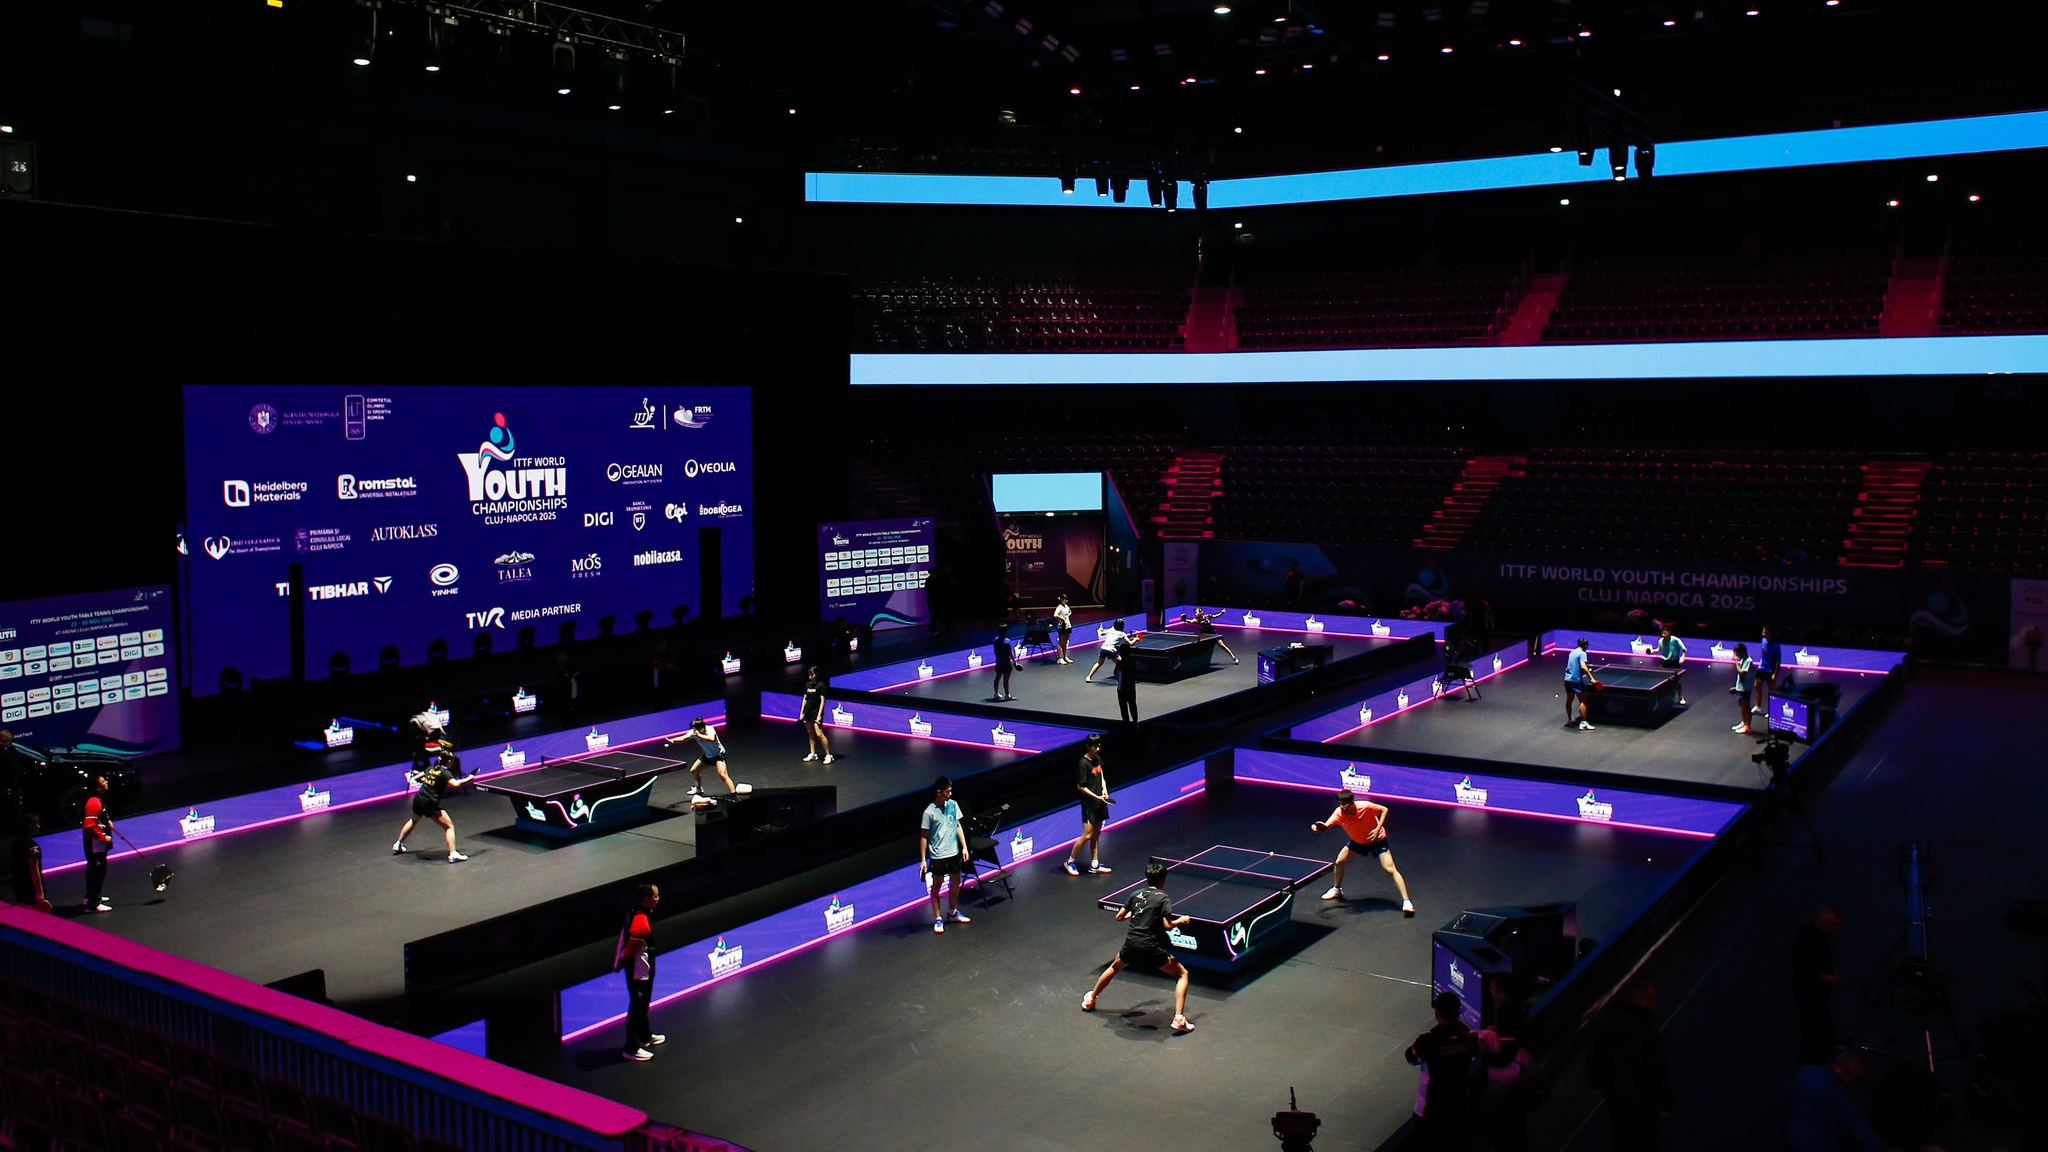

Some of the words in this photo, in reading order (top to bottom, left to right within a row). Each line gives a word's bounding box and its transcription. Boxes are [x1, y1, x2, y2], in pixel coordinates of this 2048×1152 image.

[513, 458, 533, 467] ITTF
[534, 456, 565, 467] WORLD
[700, 462, 736, 474] VEOLIA
[457, 453, 566, 501] YOUTH
[622, 464, 663, 478] GEALAN
[253, 481, 307, 492] Heidelberg
[359, 477, 417, 490] romstal
[254, 491, 301, 502] Materials
[472, 497, 567, 515] CHAMPIONSHIPS
[484, 513, 538, 525] CLUJ-NAPOCA
[539, 512, 556, 521] 2025
[584, 512, 614, 527] DIGI
[371, 523, 438, 541] AUTOKLASS
[498, 567, 532, 580] TALEA
[1500, 564, 1537, 578] ITTF
[1541, 566, 1605, 582] WORLD
[1610, 569, 1675, 586] YOUTH
[1680, 572, 1848, 595] CHAMPIONSHIPS
[309, 582, 369, 600] TIBHAR
[431, 588, 459, 596] YINHE
[1577, 587, 1620, 603] CLUJ
[1626, 590, 1704, 608] NAPOCA
[1709, 594, 1756, 610] 2025
[511, 608, 541, 621] MEDIA
[541, 603, 581, 617] PARTNER
[124, 649, 139, 657] DIGI
[6, 711, 23, 719] DIGI
